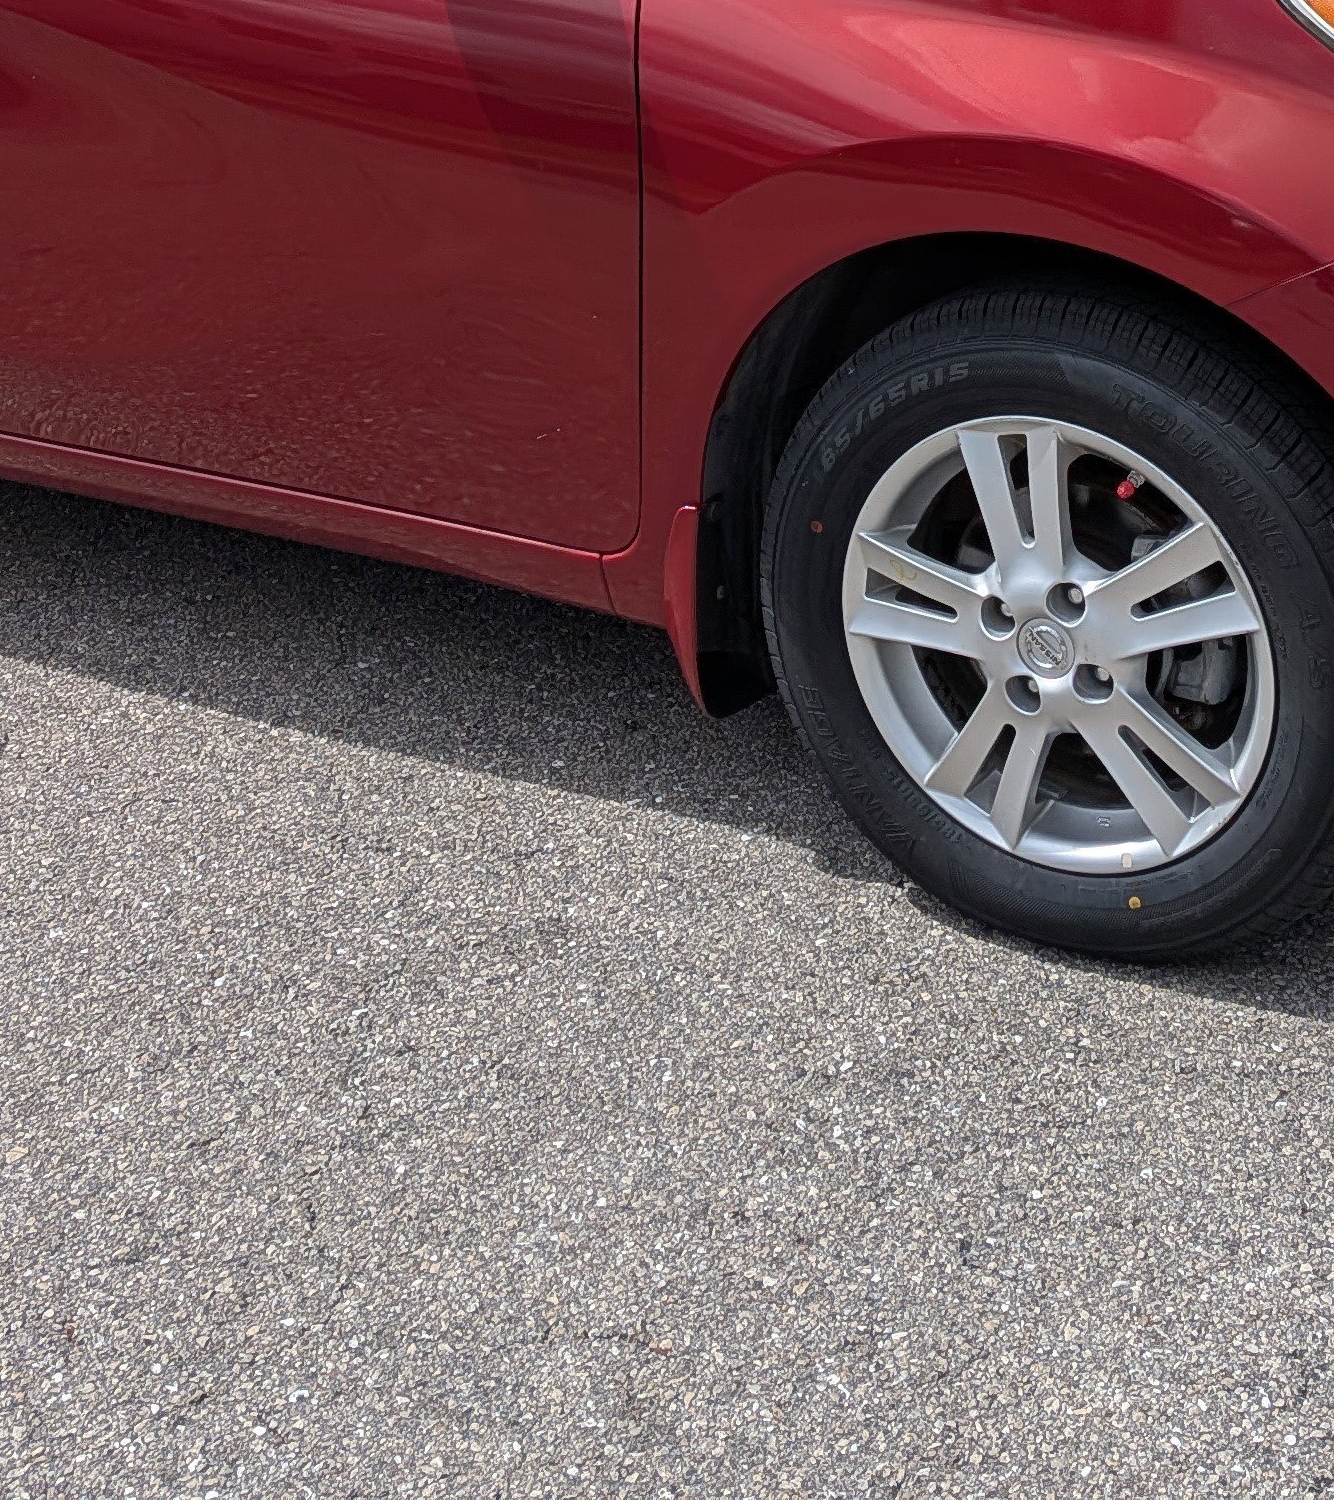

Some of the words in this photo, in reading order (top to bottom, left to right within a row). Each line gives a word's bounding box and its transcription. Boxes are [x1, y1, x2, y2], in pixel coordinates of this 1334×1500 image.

[819, 361, 970, 474] 85/65R15
[1111, 384, 1301, 569] TOURING
[1027, 628, 1062, 666] NISSAN
